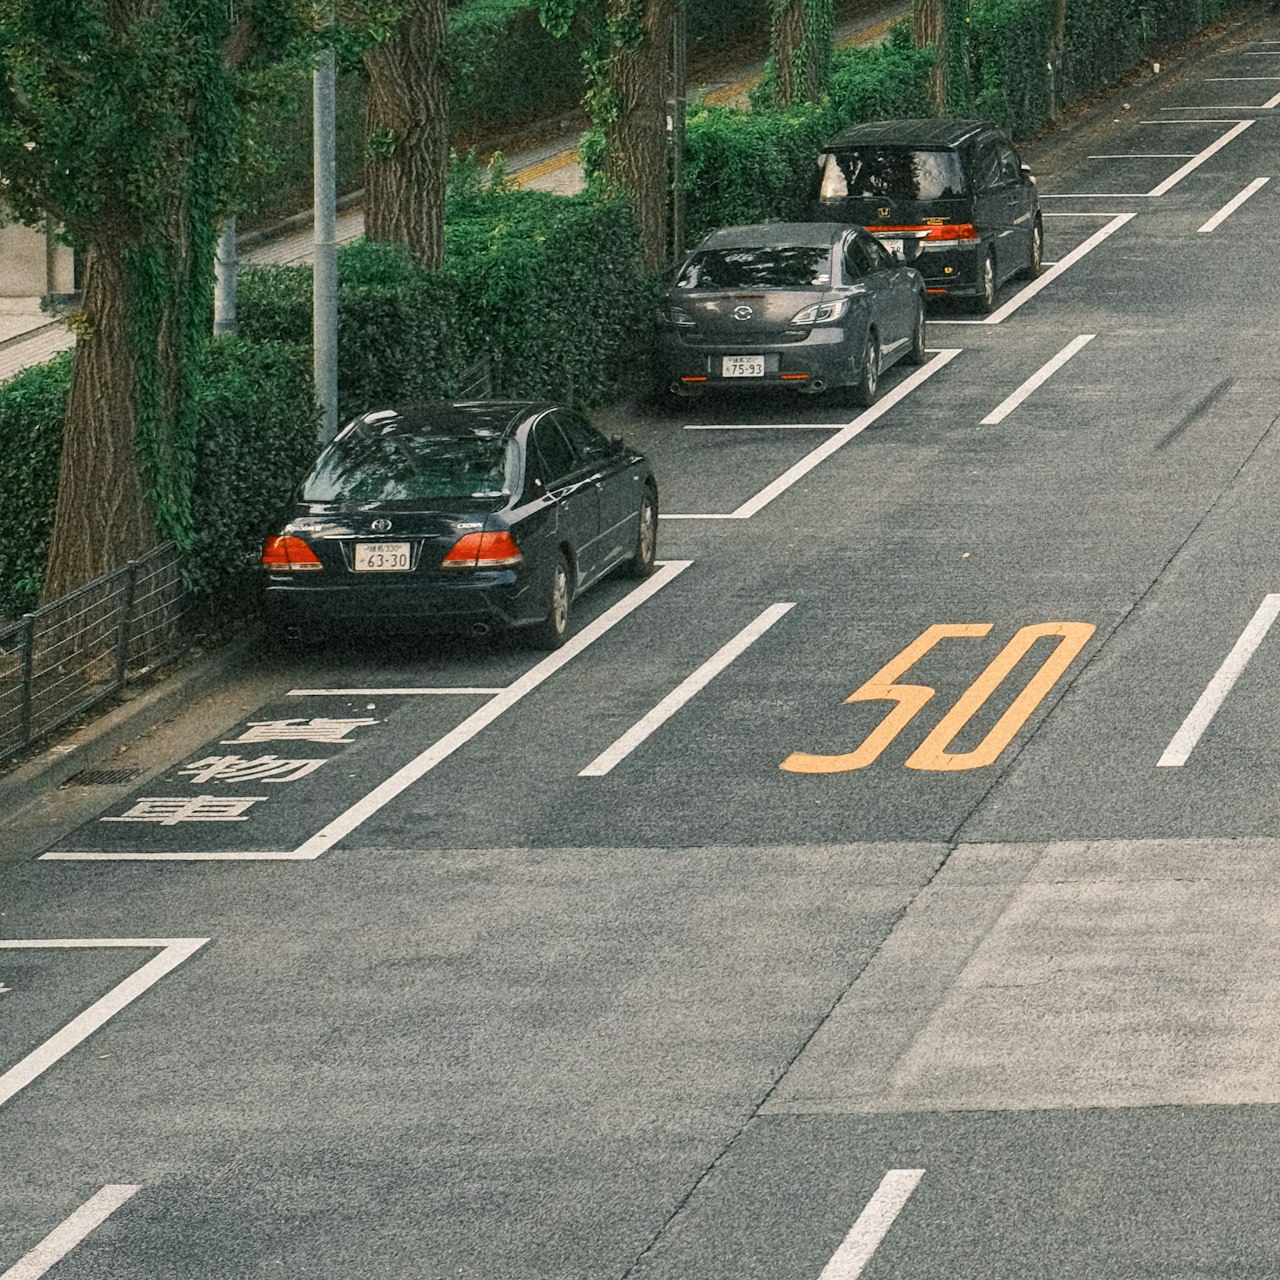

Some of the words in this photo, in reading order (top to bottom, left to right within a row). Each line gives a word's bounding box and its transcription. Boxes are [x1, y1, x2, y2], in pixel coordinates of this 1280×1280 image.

[732, 364, 762, 375] 75-93
[367, 554, 407, 567] 63-30
[779, 621, 1098, 773] 50
